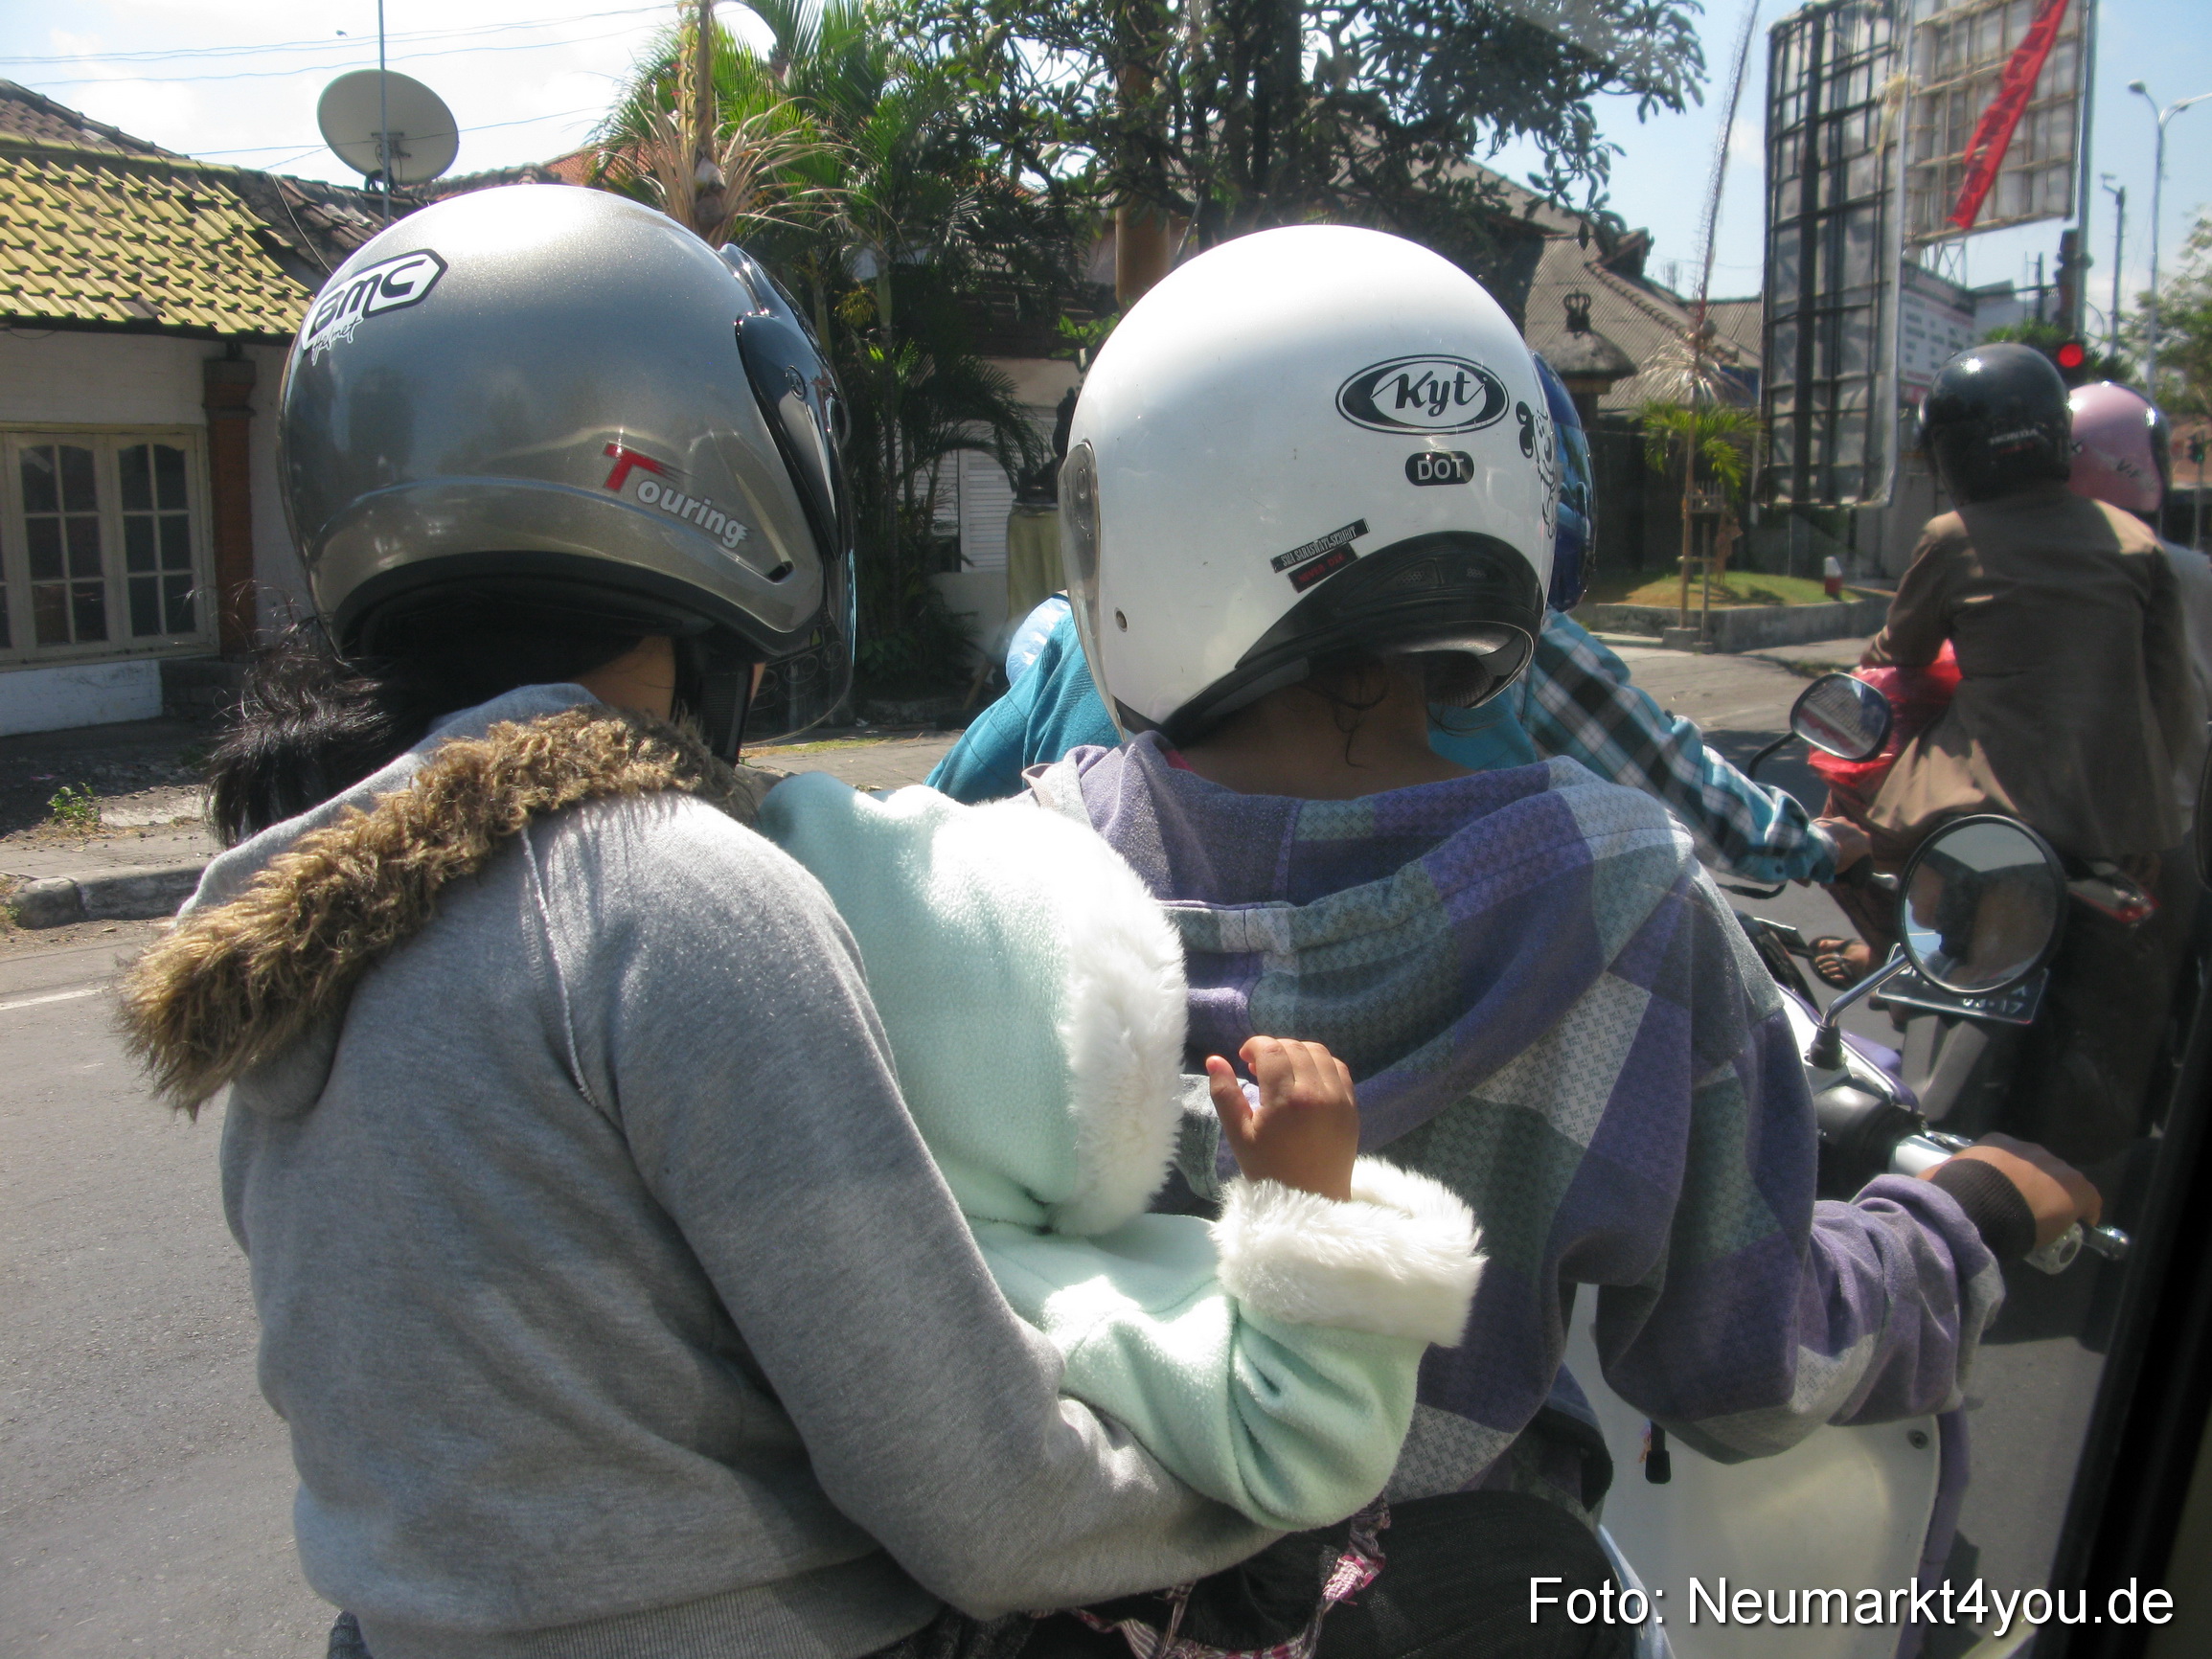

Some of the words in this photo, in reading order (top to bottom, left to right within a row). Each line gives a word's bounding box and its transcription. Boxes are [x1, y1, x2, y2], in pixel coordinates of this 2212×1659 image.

[308, 258, 428, 341] BMC
[312, 316, 363, 365] Helmet
[603, 442, 753, 550] Touring
[1417, 458, 1465, 481] DOT
